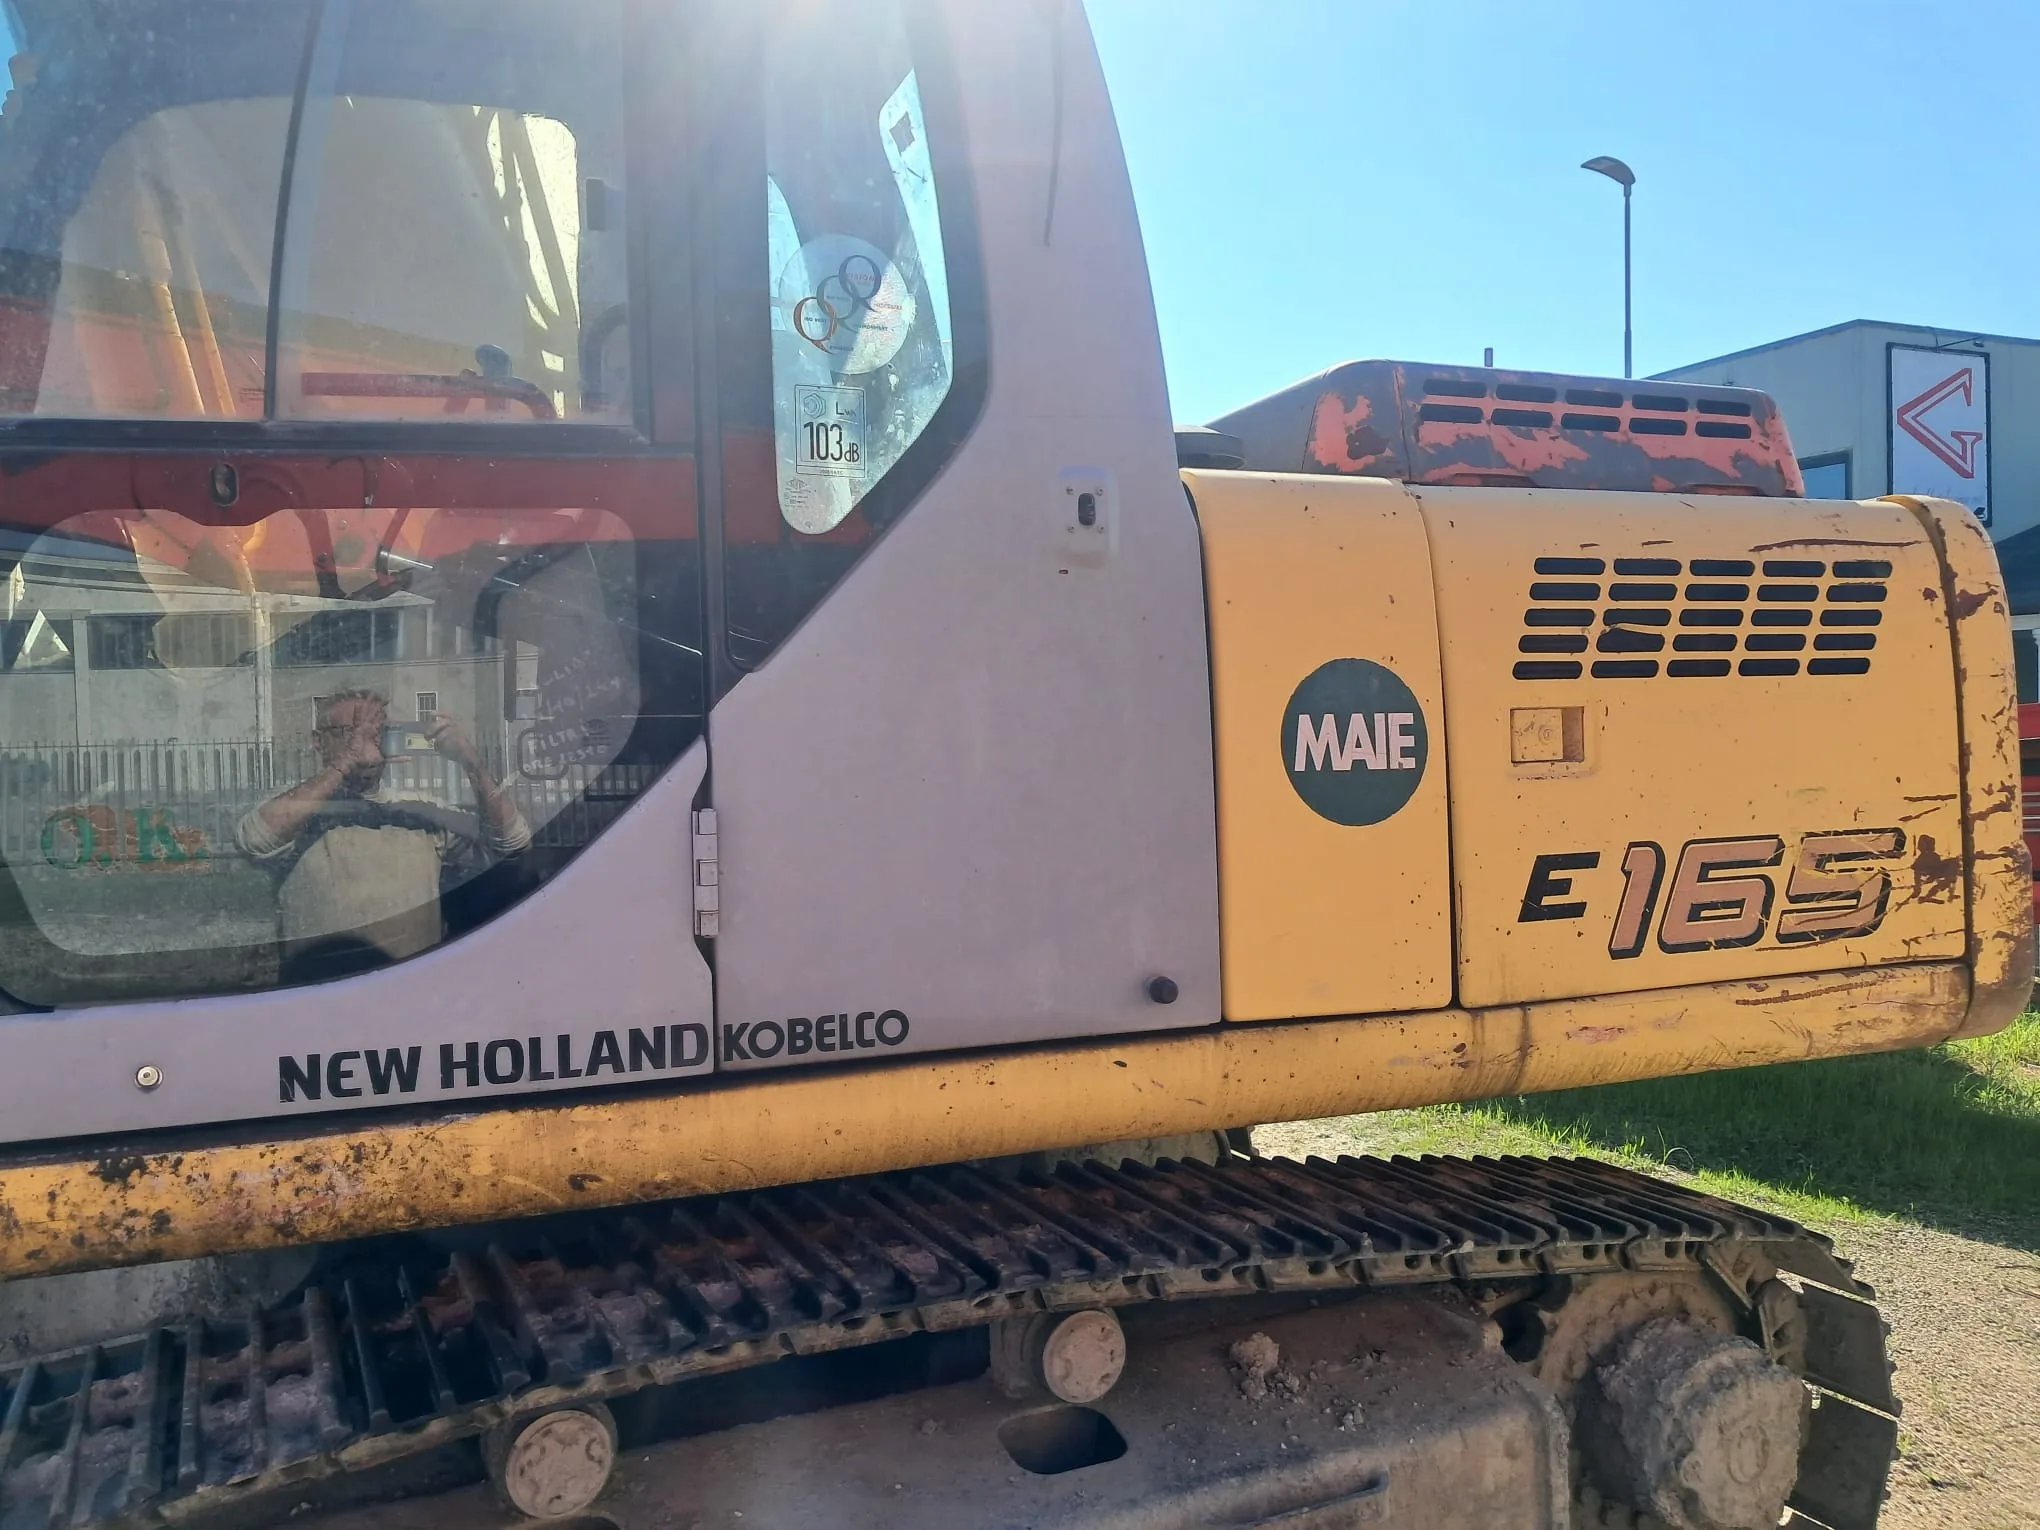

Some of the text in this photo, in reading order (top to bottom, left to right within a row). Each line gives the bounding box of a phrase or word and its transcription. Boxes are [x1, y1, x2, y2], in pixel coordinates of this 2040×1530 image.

[1294, 712, 1416, 771] MAIE
[1518, 827, 1907, 960] E 165
[279, 1009, 910, 1103] NEW HOLLAND KOBELCO
